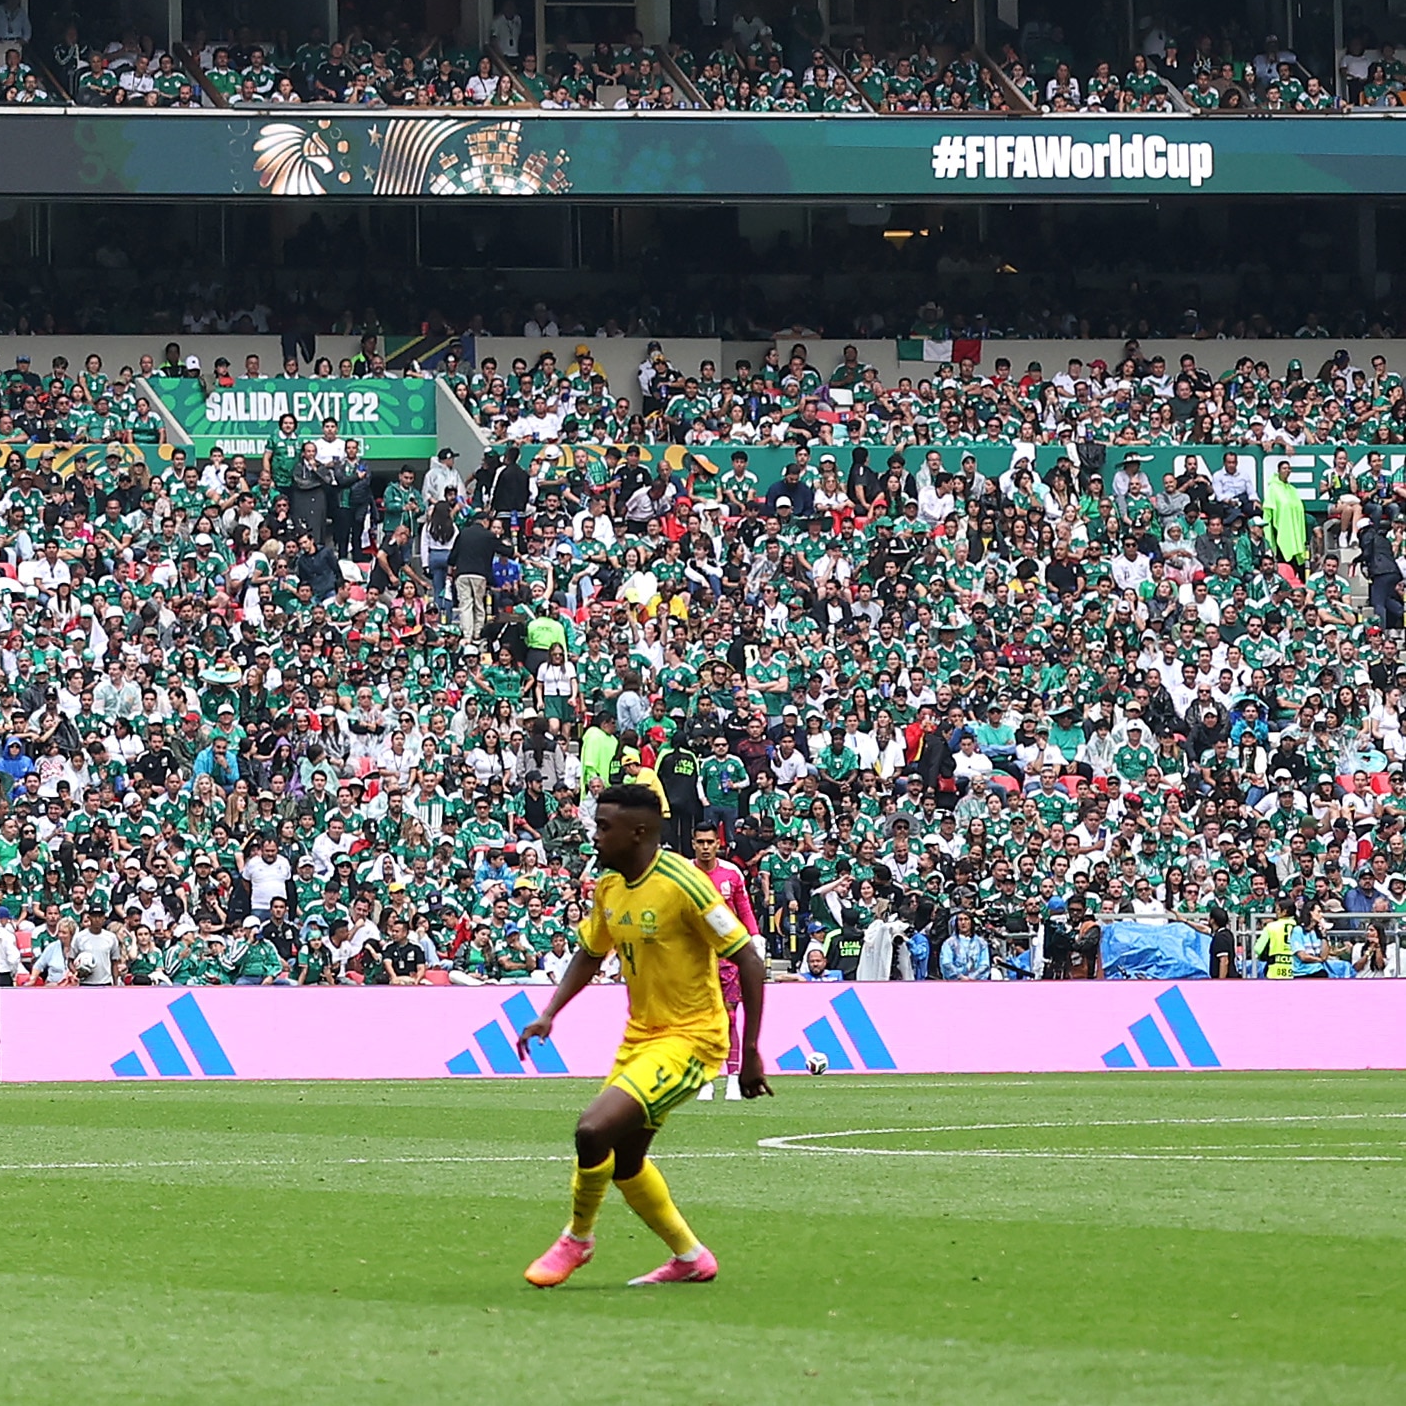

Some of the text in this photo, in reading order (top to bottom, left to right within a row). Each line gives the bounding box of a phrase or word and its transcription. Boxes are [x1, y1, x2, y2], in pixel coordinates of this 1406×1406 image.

[931, 133, 1213, 187] #FIFAWorldCup
[205, 391, 380, 422] SALIDA EXIT 22
[216, 438, 256, 455] SALIDA
[257, 439, 268, 454] D
[839, 940, 862, 949] LOCAL
[840, 948, 861, 957] CREW
